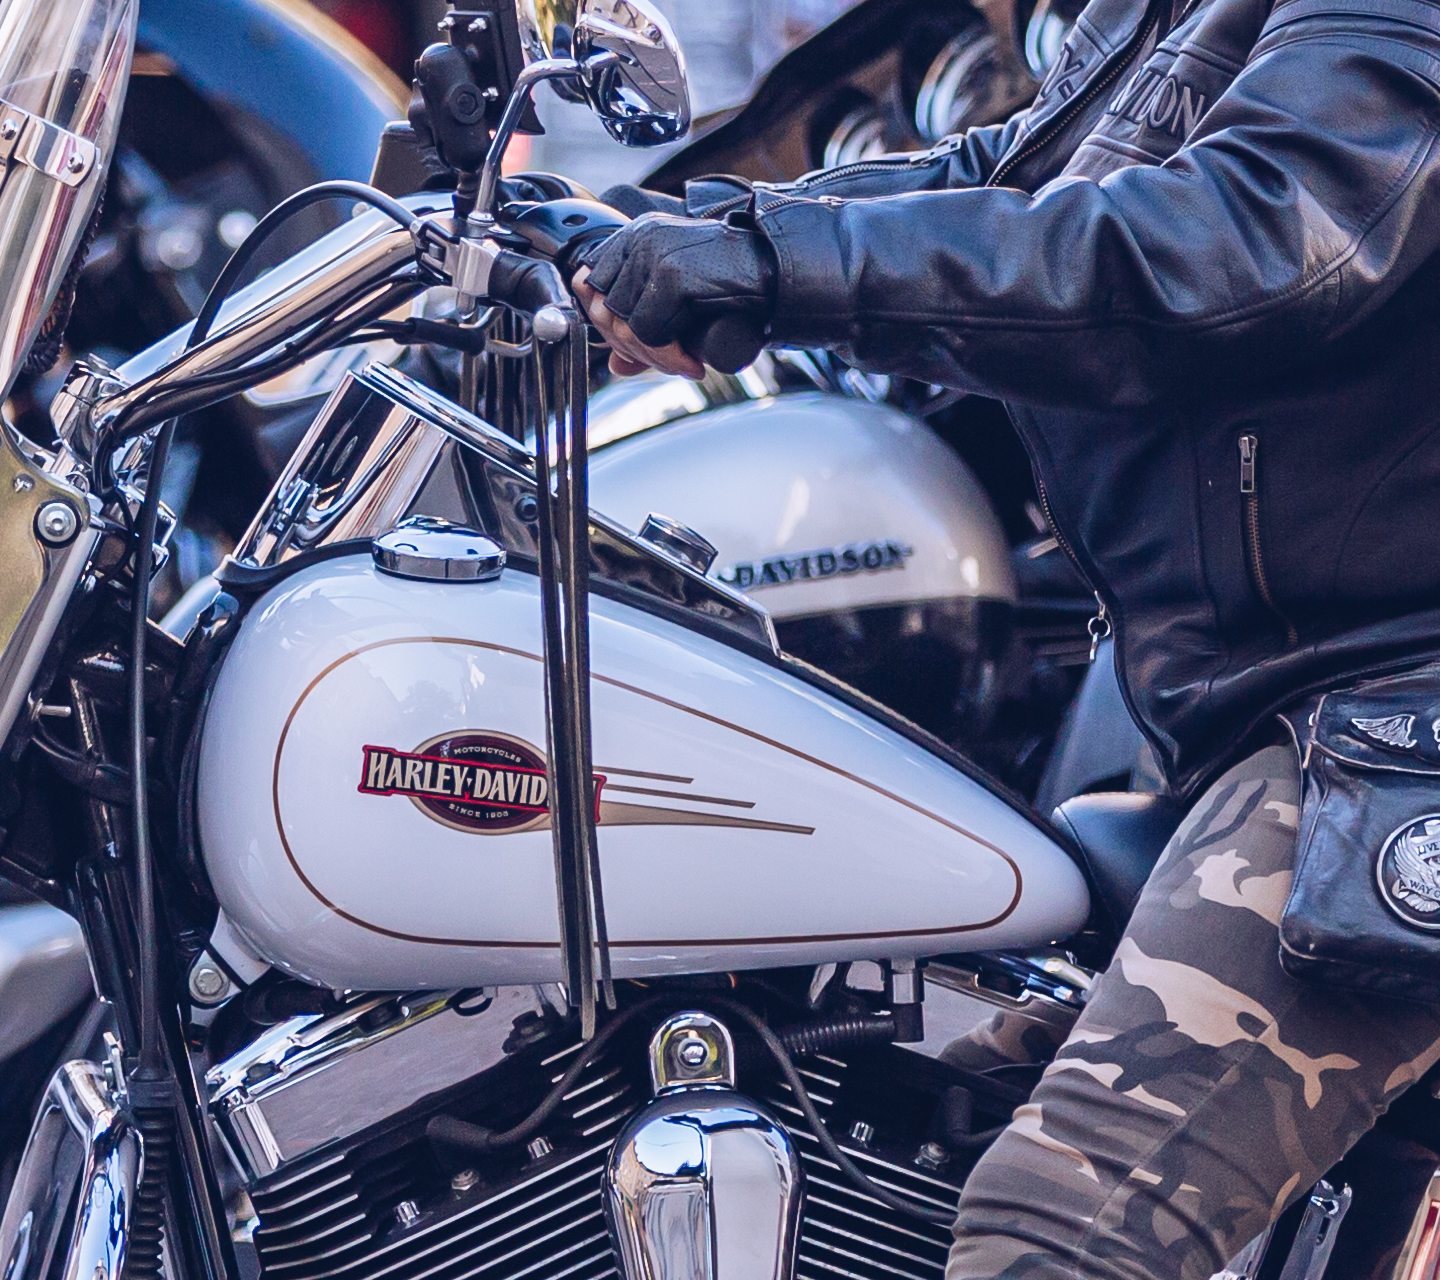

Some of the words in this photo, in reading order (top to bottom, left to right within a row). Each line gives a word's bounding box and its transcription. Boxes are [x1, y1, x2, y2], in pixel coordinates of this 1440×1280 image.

[454, 746, 522, 763] MOTORCYCLES
[448, 803, 481, 818] SINCE
[1418, 841, 1439, 855] LIVE
[1409, 879, 1433, 894] WAY
